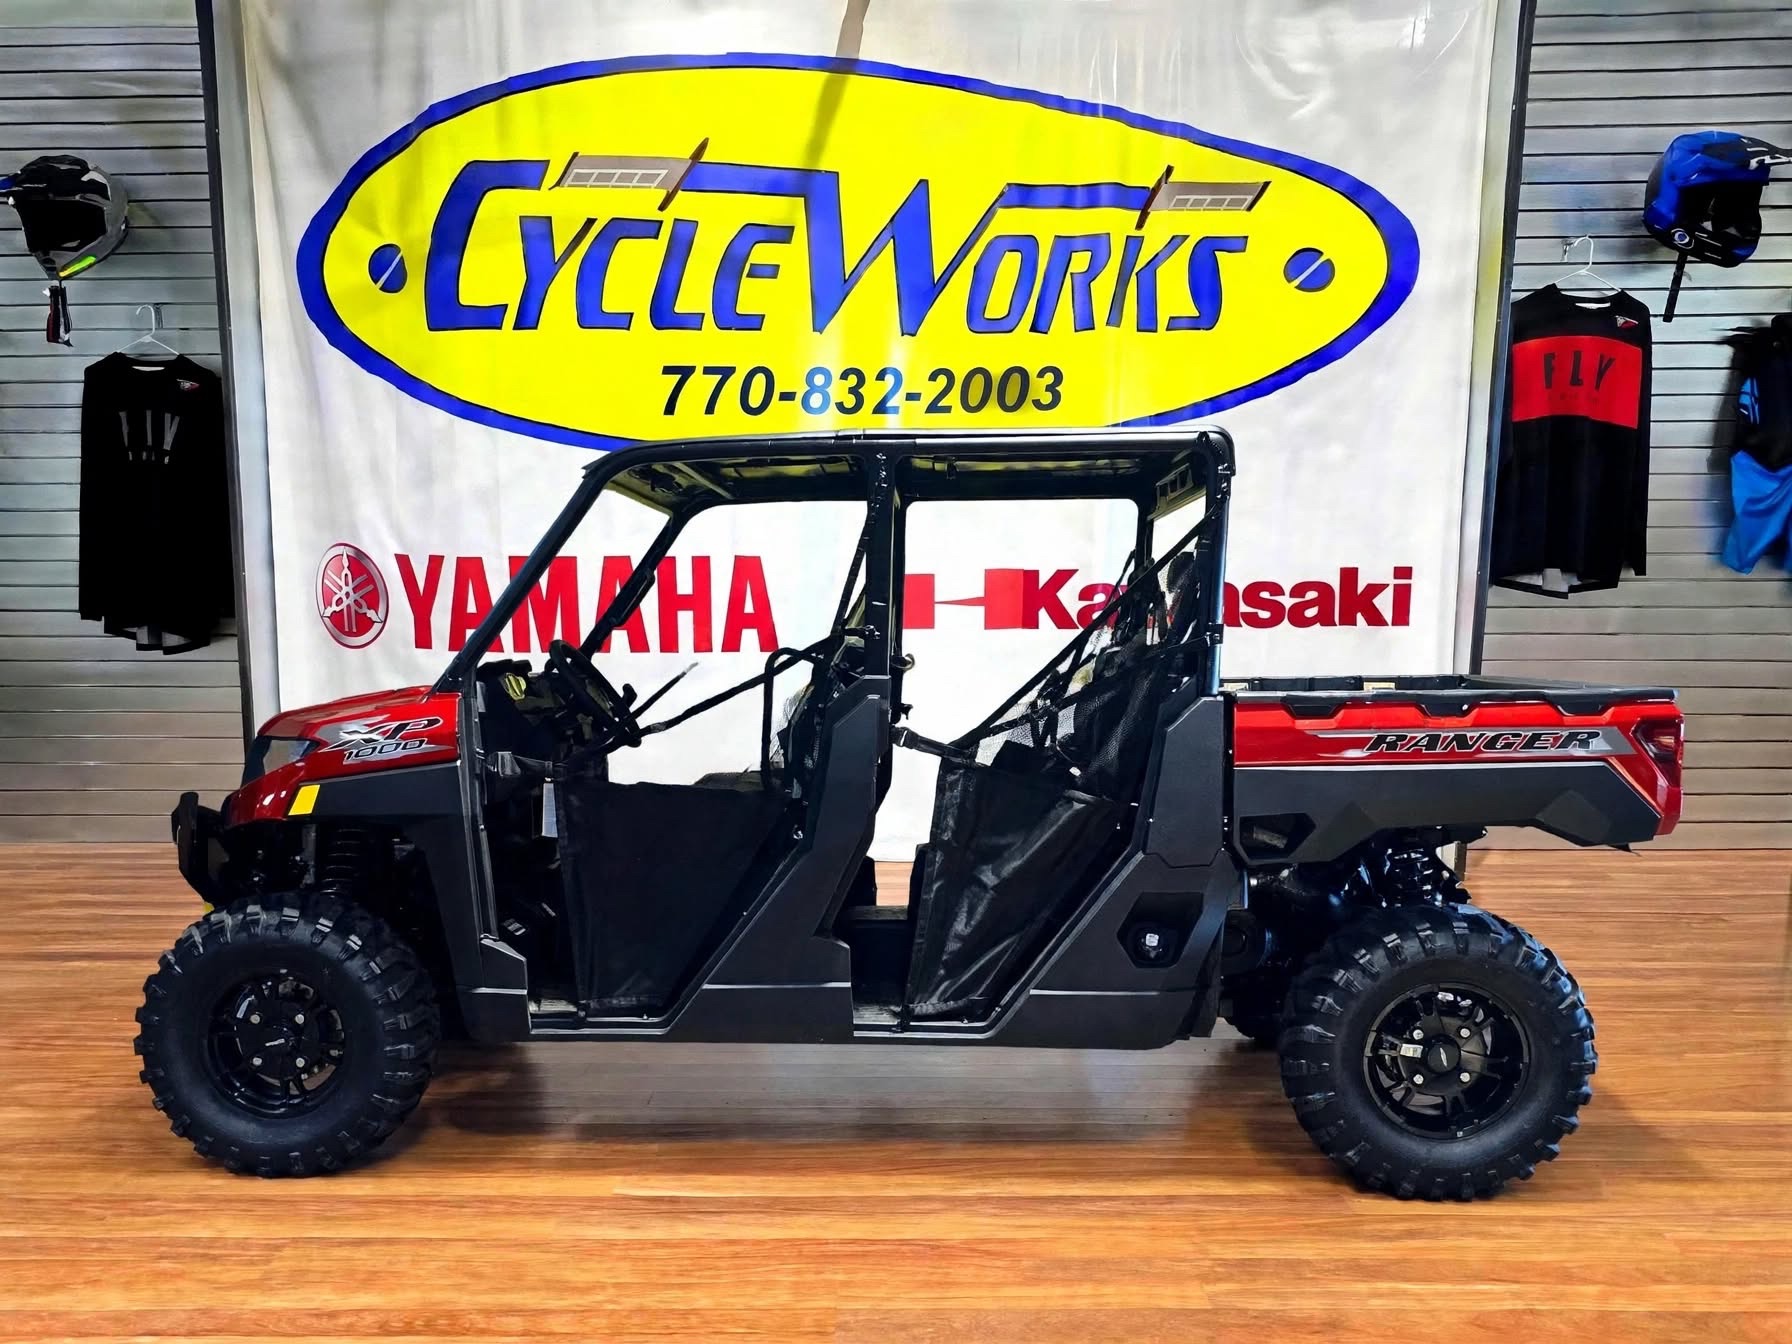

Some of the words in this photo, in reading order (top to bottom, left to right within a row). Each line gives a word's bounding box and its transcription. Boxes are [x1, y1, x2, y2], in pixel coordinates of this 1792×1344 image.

[660, 365, 1063, 416] 770-832-2003
[1543, 350, 1615, 391] FLY
[394, 553, 780, 653] YAMAHA
[1023, 566, 1413, 630] Kasaki
[318, 716, 443, 753] XP
[344, 738, 427, 761] 1000
[1364, 730, 1601, 752] RANGER
